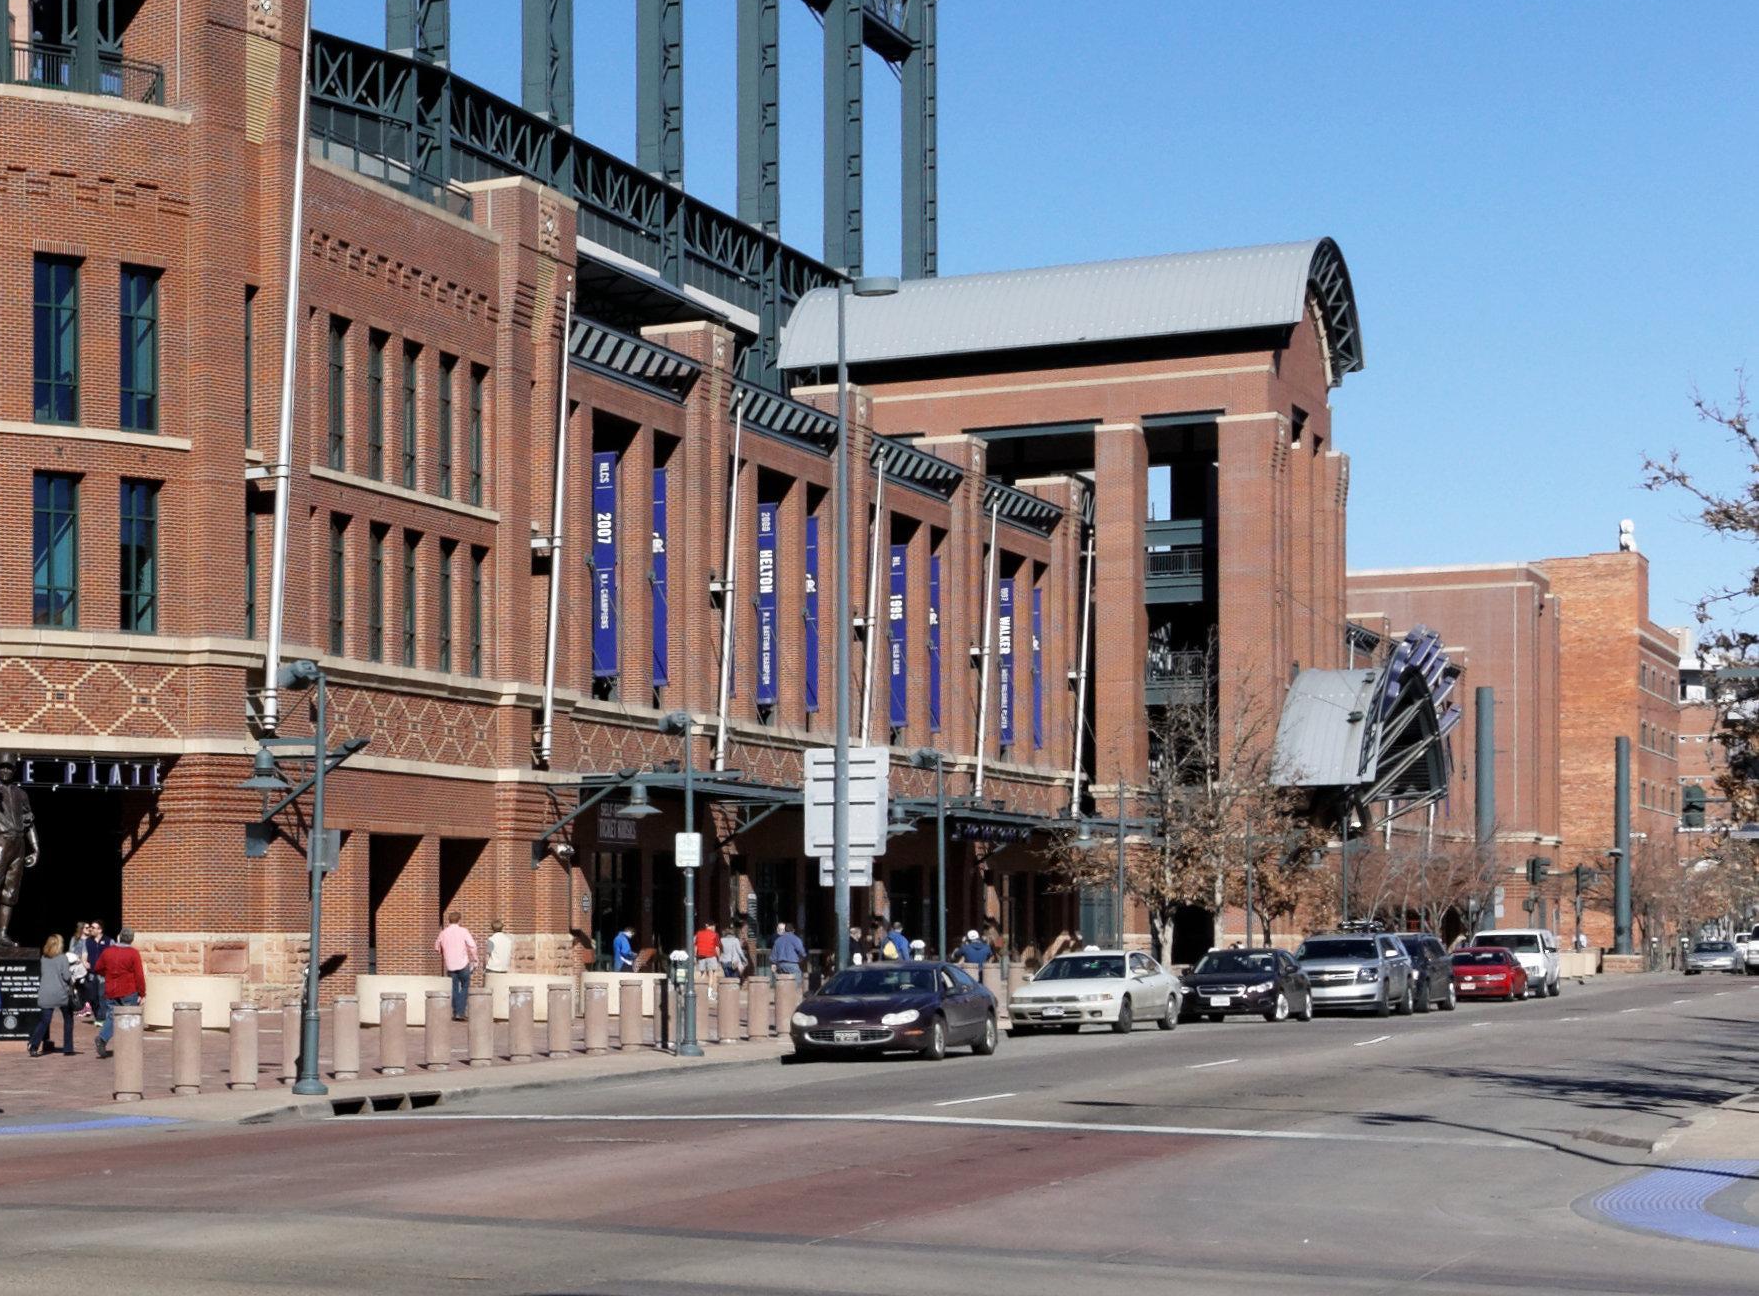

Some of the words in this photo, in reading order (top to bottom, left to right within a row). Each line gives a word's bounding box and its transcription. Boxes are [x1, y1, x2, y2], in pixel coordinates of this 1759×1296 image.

[596, 512, 612, 545] 2007
[759, 549, 773, 594] HELTON
[890, 594, 903, 620] 1995
[999, 616, 1011, 654] WALKER
[65, 761, 161, 785] PLATE
